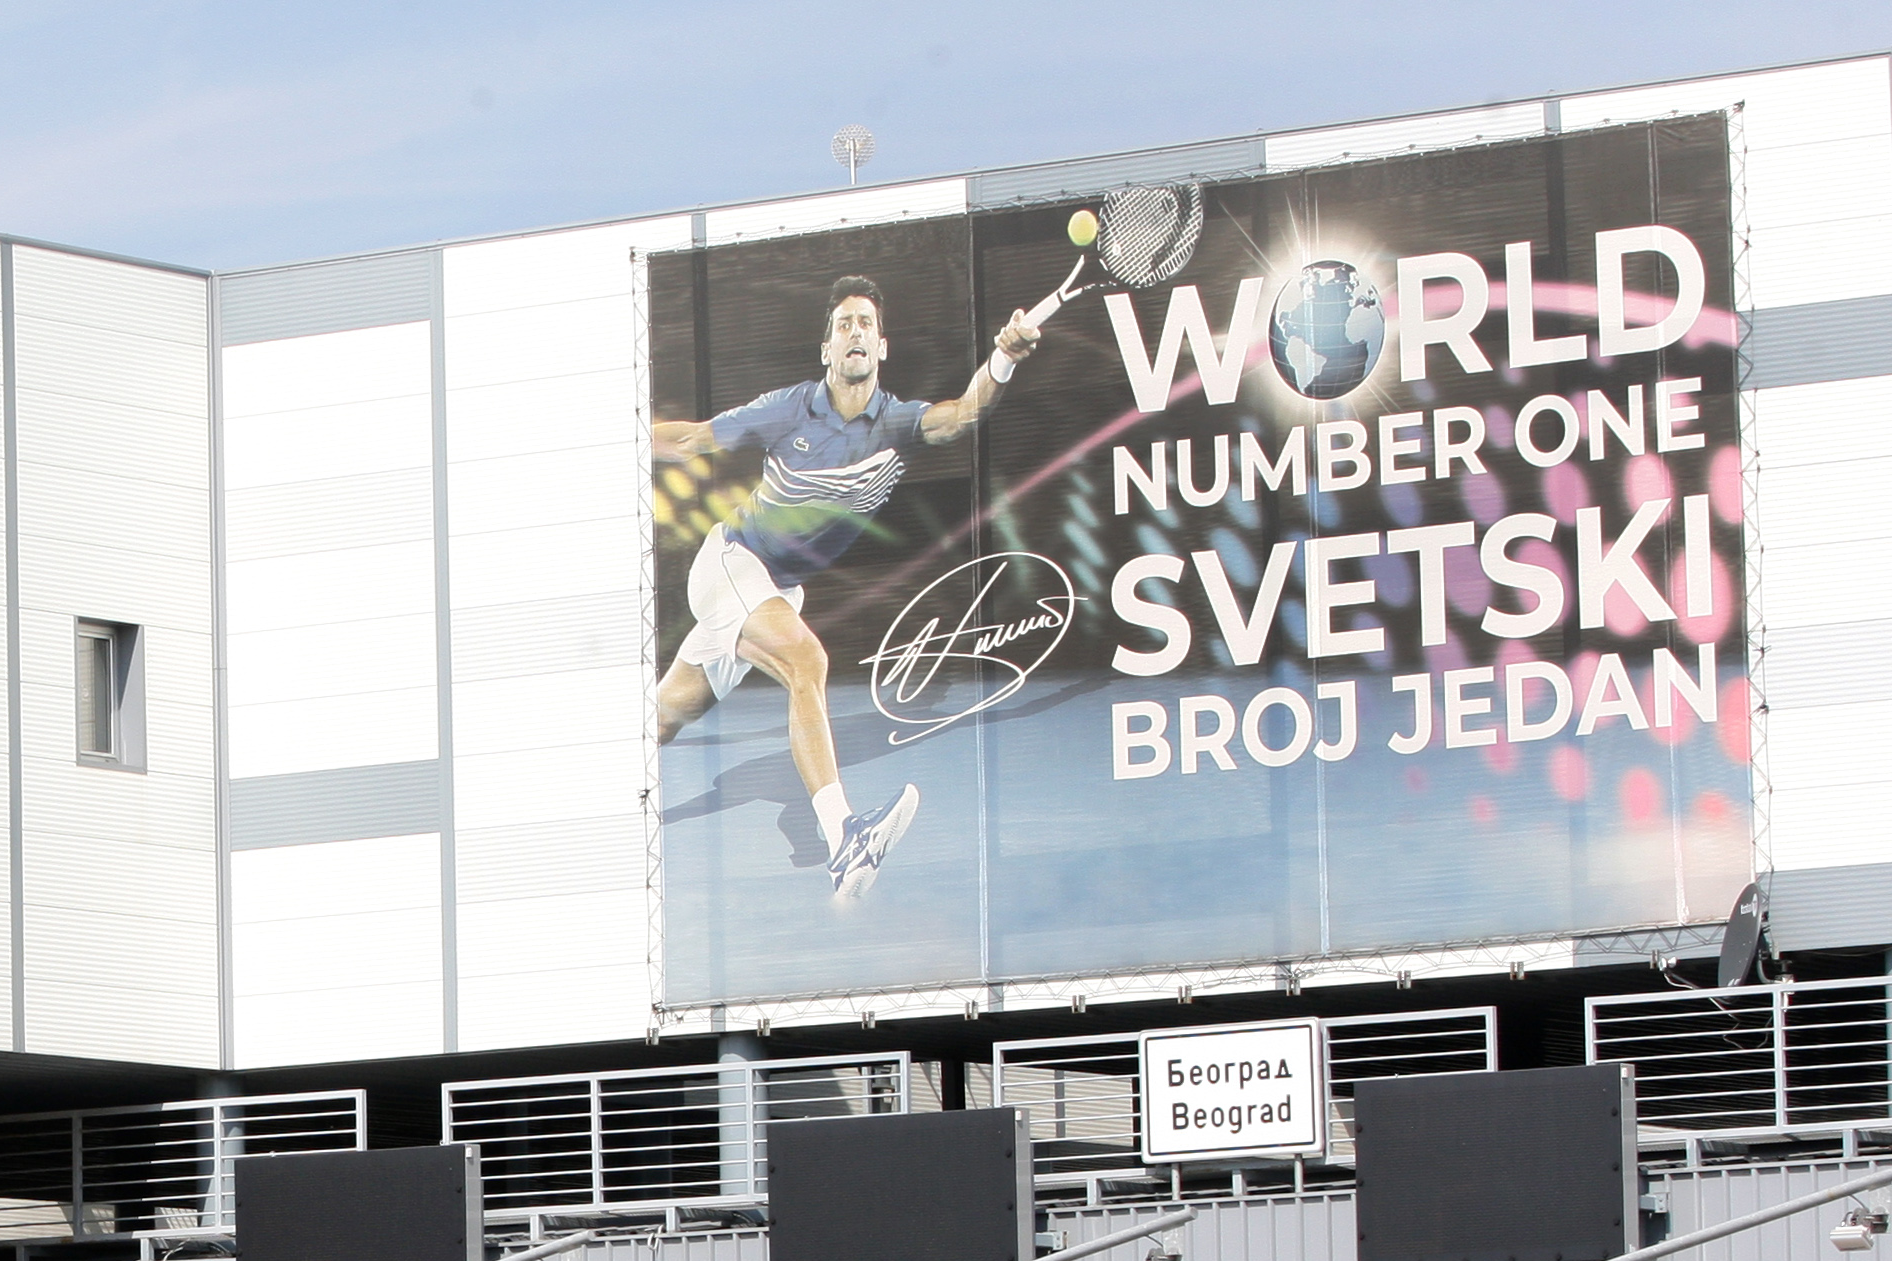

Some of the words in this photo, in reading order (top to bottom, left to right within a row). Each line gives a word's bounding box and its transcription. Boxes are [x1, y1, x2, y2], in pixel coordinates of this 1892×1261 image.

[1104, 223, 1707, 414] WORLD
[1111, 404, 1488, 516] NUMBER
[1513, 377, 1706, 470] ONE
[1109, 492, 1714, 679] SVETSKI
[1110, 681, 1359, 782] BROJ
[1387, 642, 1719, 756] JEDAN
[1167, 1058, 1293, 1090] Београд
[1171, 1093, 1292, 1134] Beograd
